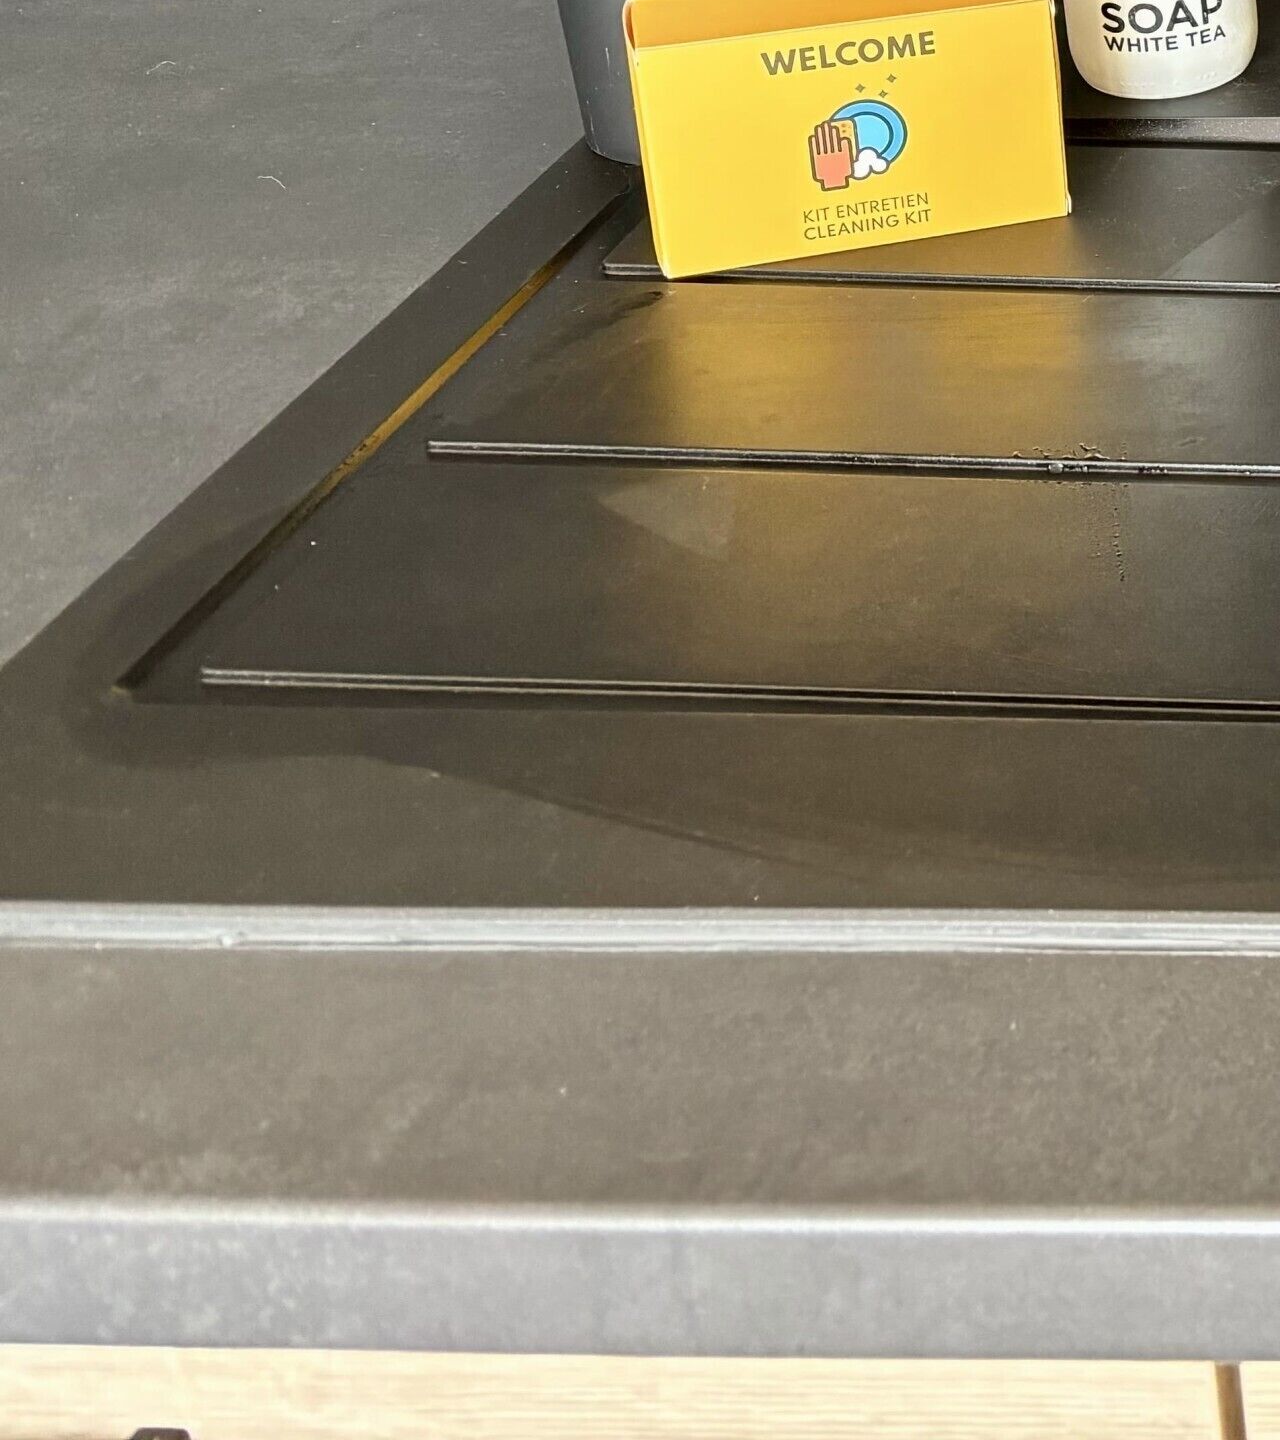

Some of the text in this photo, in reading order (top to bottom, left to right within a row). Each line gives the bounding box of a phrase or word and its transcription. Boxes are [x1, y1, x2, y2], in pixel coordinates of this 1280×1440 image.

[760, 30, 936, 76] WELCOME
[1103, 24, 1226, 53] WHITE TEA
[802, 192, 930, 224] KIT ENTRETIEN
[803, 209, 932, 241] CLEANING KIT
